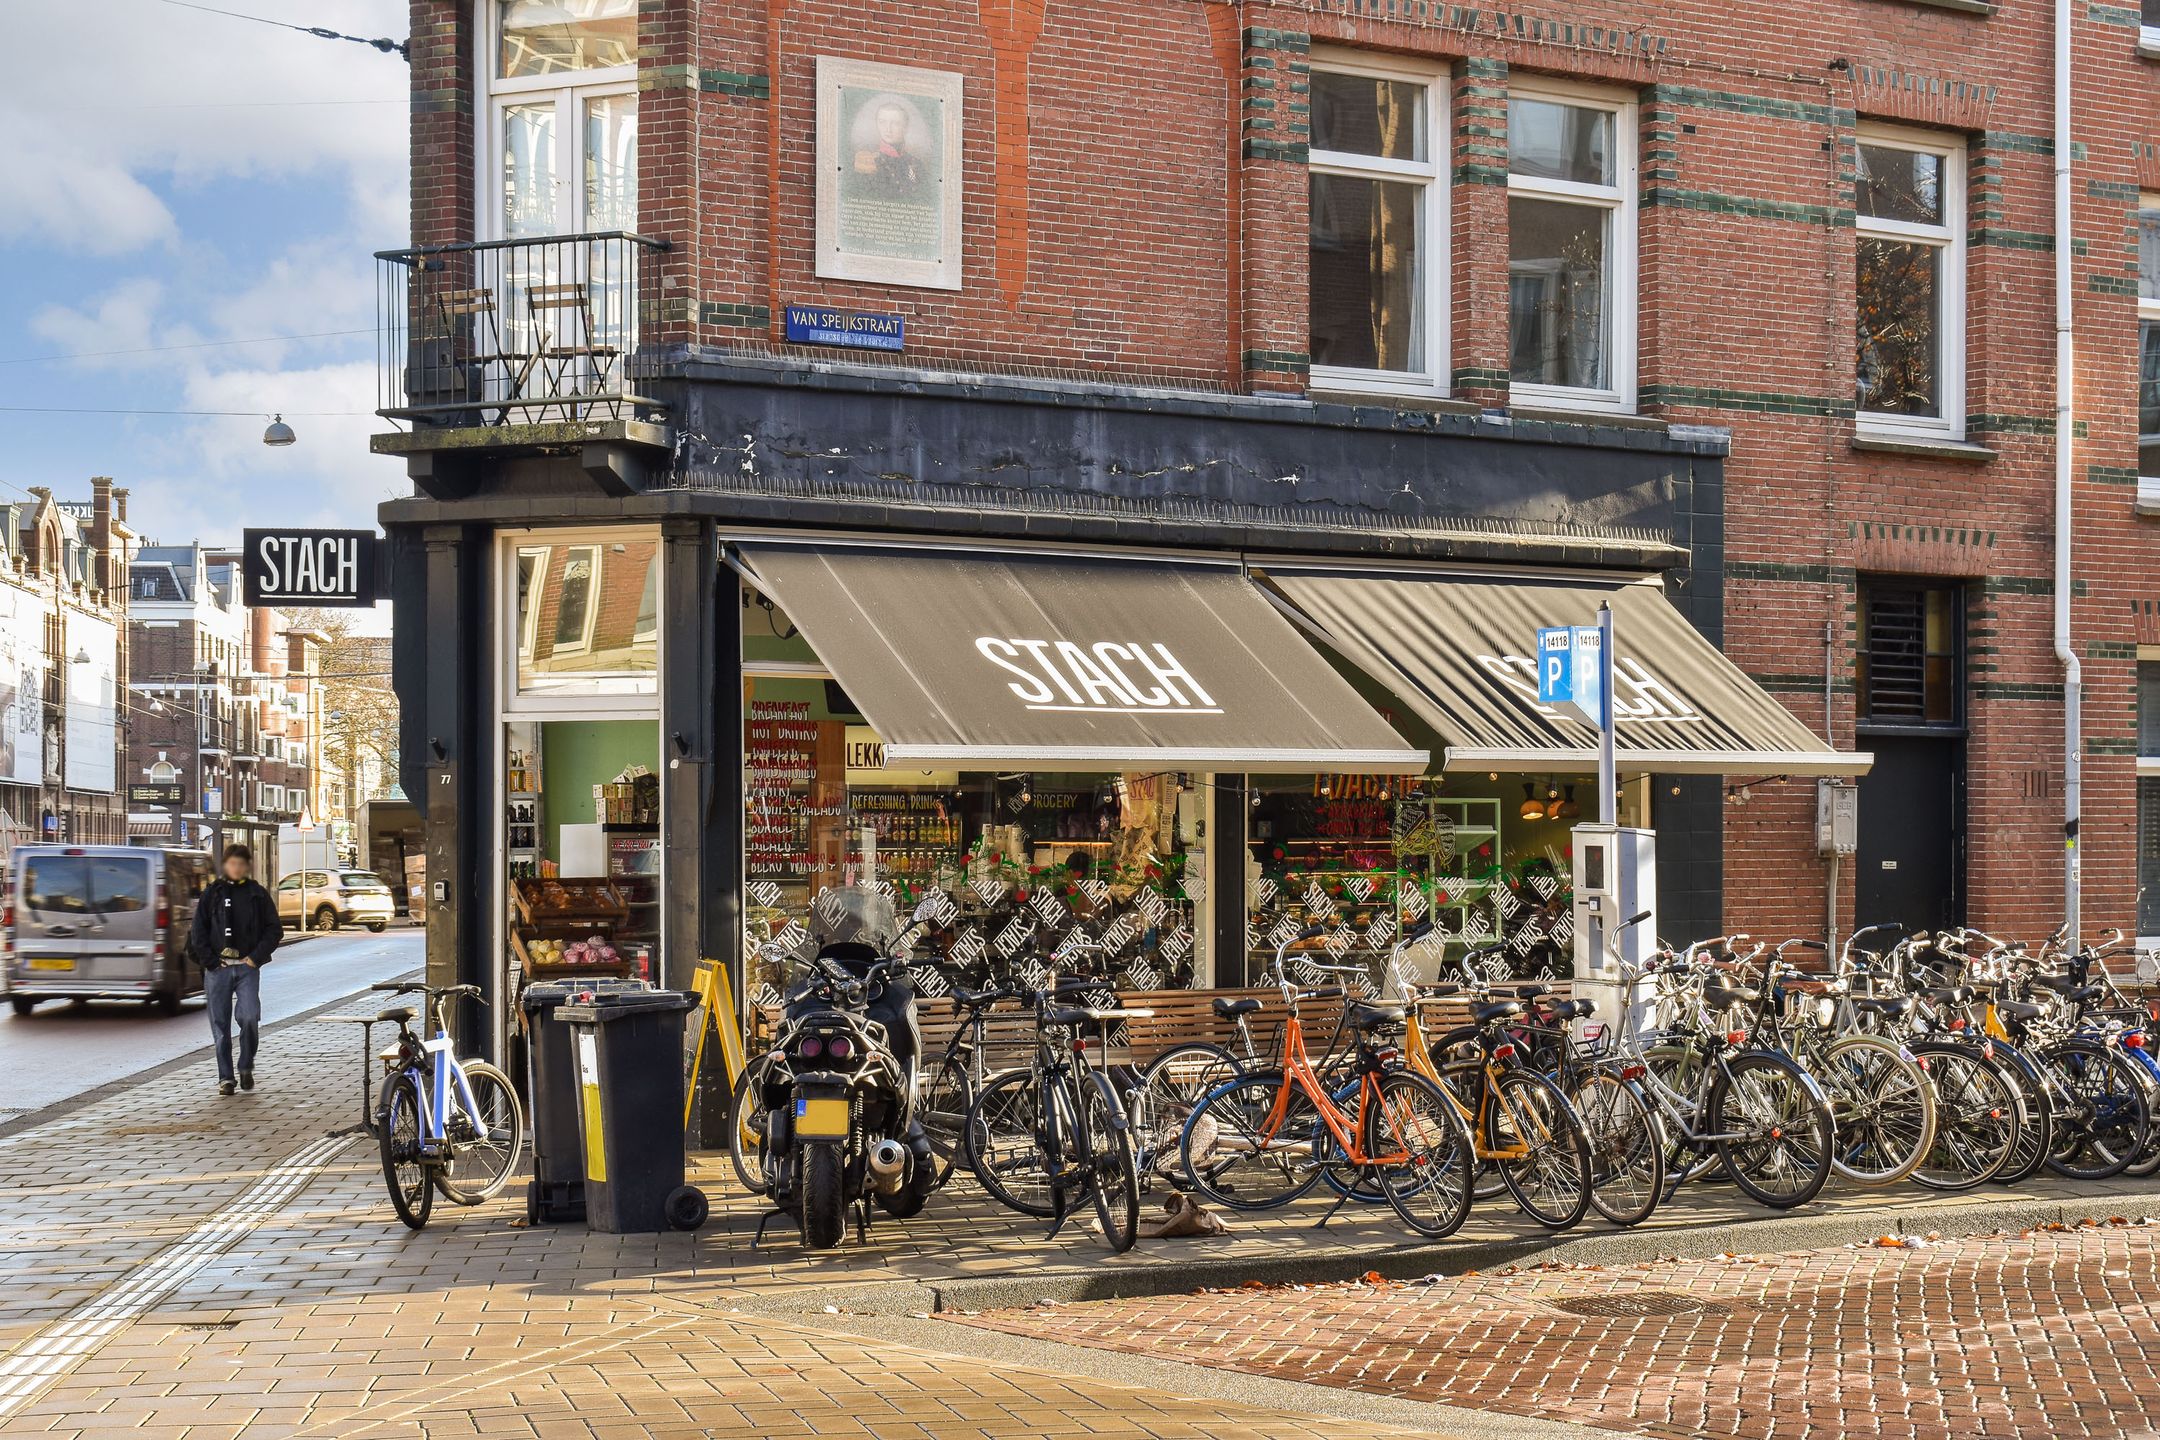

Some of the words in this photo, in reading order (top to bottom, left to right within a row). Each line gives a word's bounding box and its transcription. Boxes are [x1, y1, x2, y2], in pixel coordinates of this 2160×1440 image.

[792, 311, 817, 327] VAN
[822, 314, 899, 335] SPEIJKSTRAAT
[260, 537, 357, 592] STACH
[1547, 636, 1568, 648] 14118
[1580, 635, 1600, 647] 14118
[975, 637, 1217, 707] STACH
[1548, 656, 1562, 696] P
[1581, 655, 1594, 695] P
[751, 700, 811, 721] BREAKFAST
[752, 722, 772, 740] HOT
[778, 722, 818, 741] DRINKS
[441, 775, 451, 784] 77
[851, 794, 906, 810] REFRESHING
[1031, 885, 1066, 926] STACH
[1136, 884, 1169, 925] STACH
[1303, 881, 1334, 920] STACH
[1399, 881, 1429, 920] STACH
[1490, 880, 1520, 919] STACH
[950, 928, 986, 970] STACH
[994, 917, 1031, 959] STACH
[1100, 917, 1135, 958] STACH
[1160, 925, 1194, 965] STACH
[1268, 914, 1301, 951] STACH
[1325, 922, 1358, 962] STACH
[1365, 914, 1396, 952] STACH
[1421, 921, 1452, 960] STACH
[1460, 912, 1489, 950] STACH
[1513, 920, 1543, 957] STACH
[1128, 956, 1161, 991] STACH
